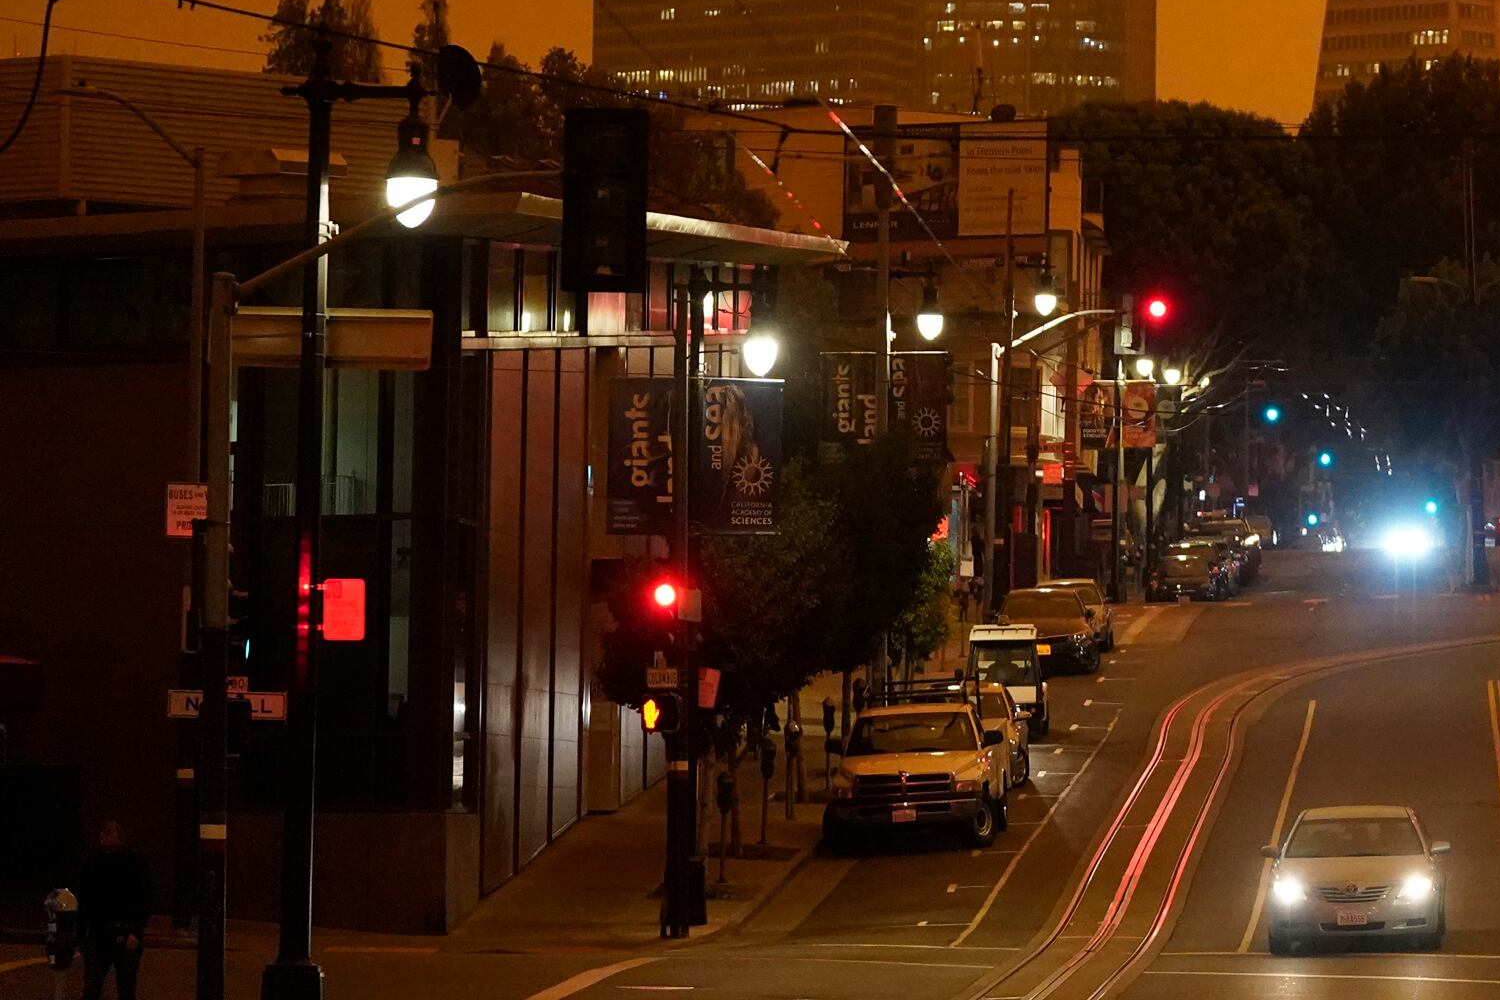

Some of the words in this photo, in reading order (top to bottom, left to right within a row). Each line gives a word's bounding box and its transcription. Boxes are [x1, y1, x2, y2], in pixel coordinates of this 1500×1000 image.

[852, 221, 898, 230] LENNR
[708, 444, 722, 471] and
[169, 489, 193, 501] BUSES
[731, 501, 773, 510] CALIFORNIA
[731, 509, 763, 518] ACADEMY
[731, 517, 774, 526] SCIENCES
